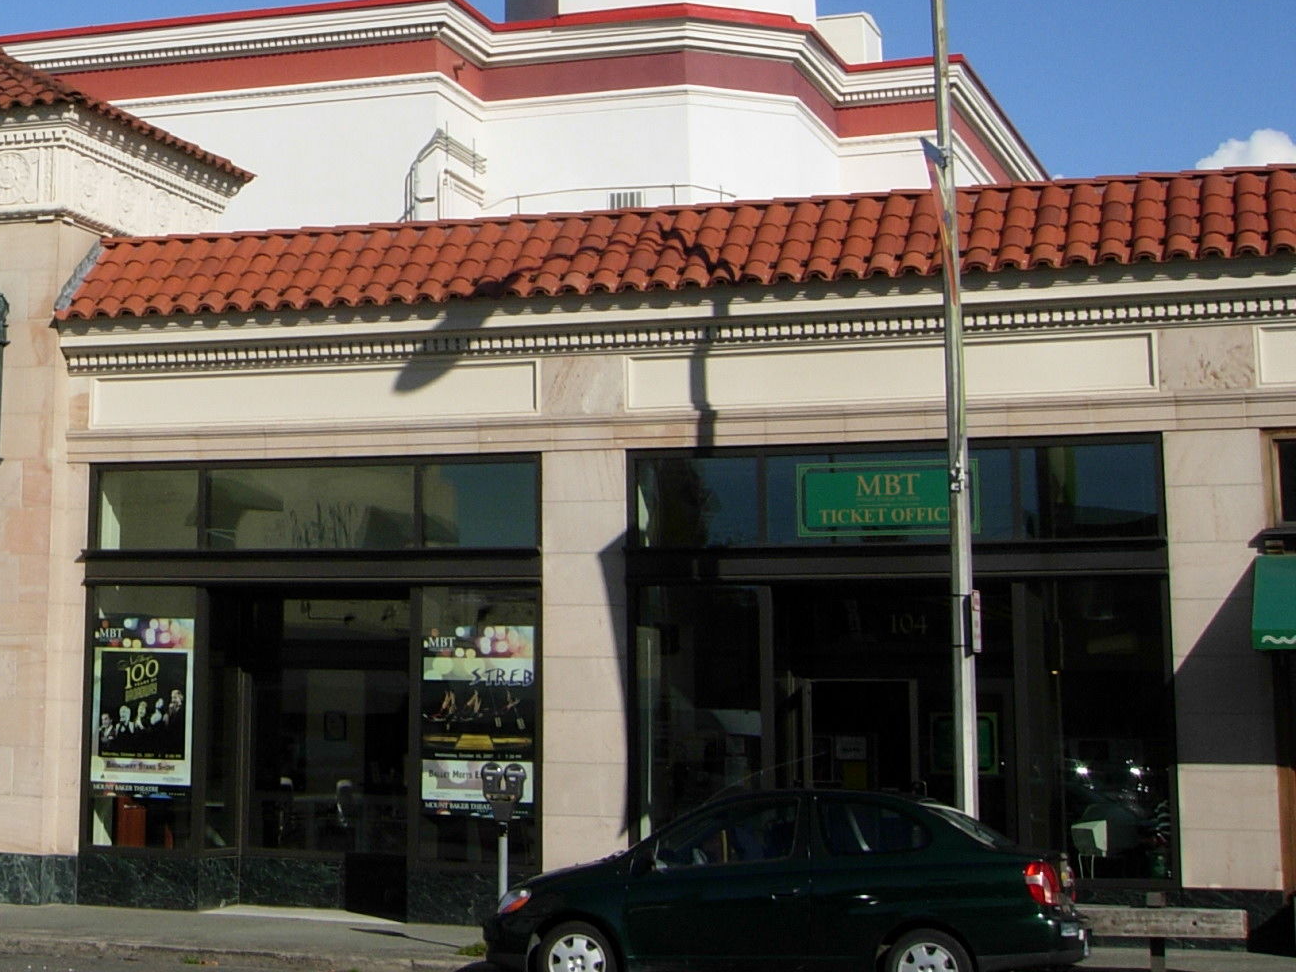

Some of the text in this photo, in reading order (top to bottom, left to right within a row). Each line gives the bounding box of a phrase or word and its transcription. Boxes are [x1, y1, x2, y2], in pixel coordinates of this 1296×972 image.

[856, 473, 920, 496] MBT
[819, 508, 888, 524] TICKET
[888, 614, 928, 635] 104
[99, 628, 124, 639] MBT
[429, 637, 456, 648] MBT
[125, 660, 159, 689] 100
[469, 668, 533, 687] STREB
[470, 803, 492, 811] THEAT
